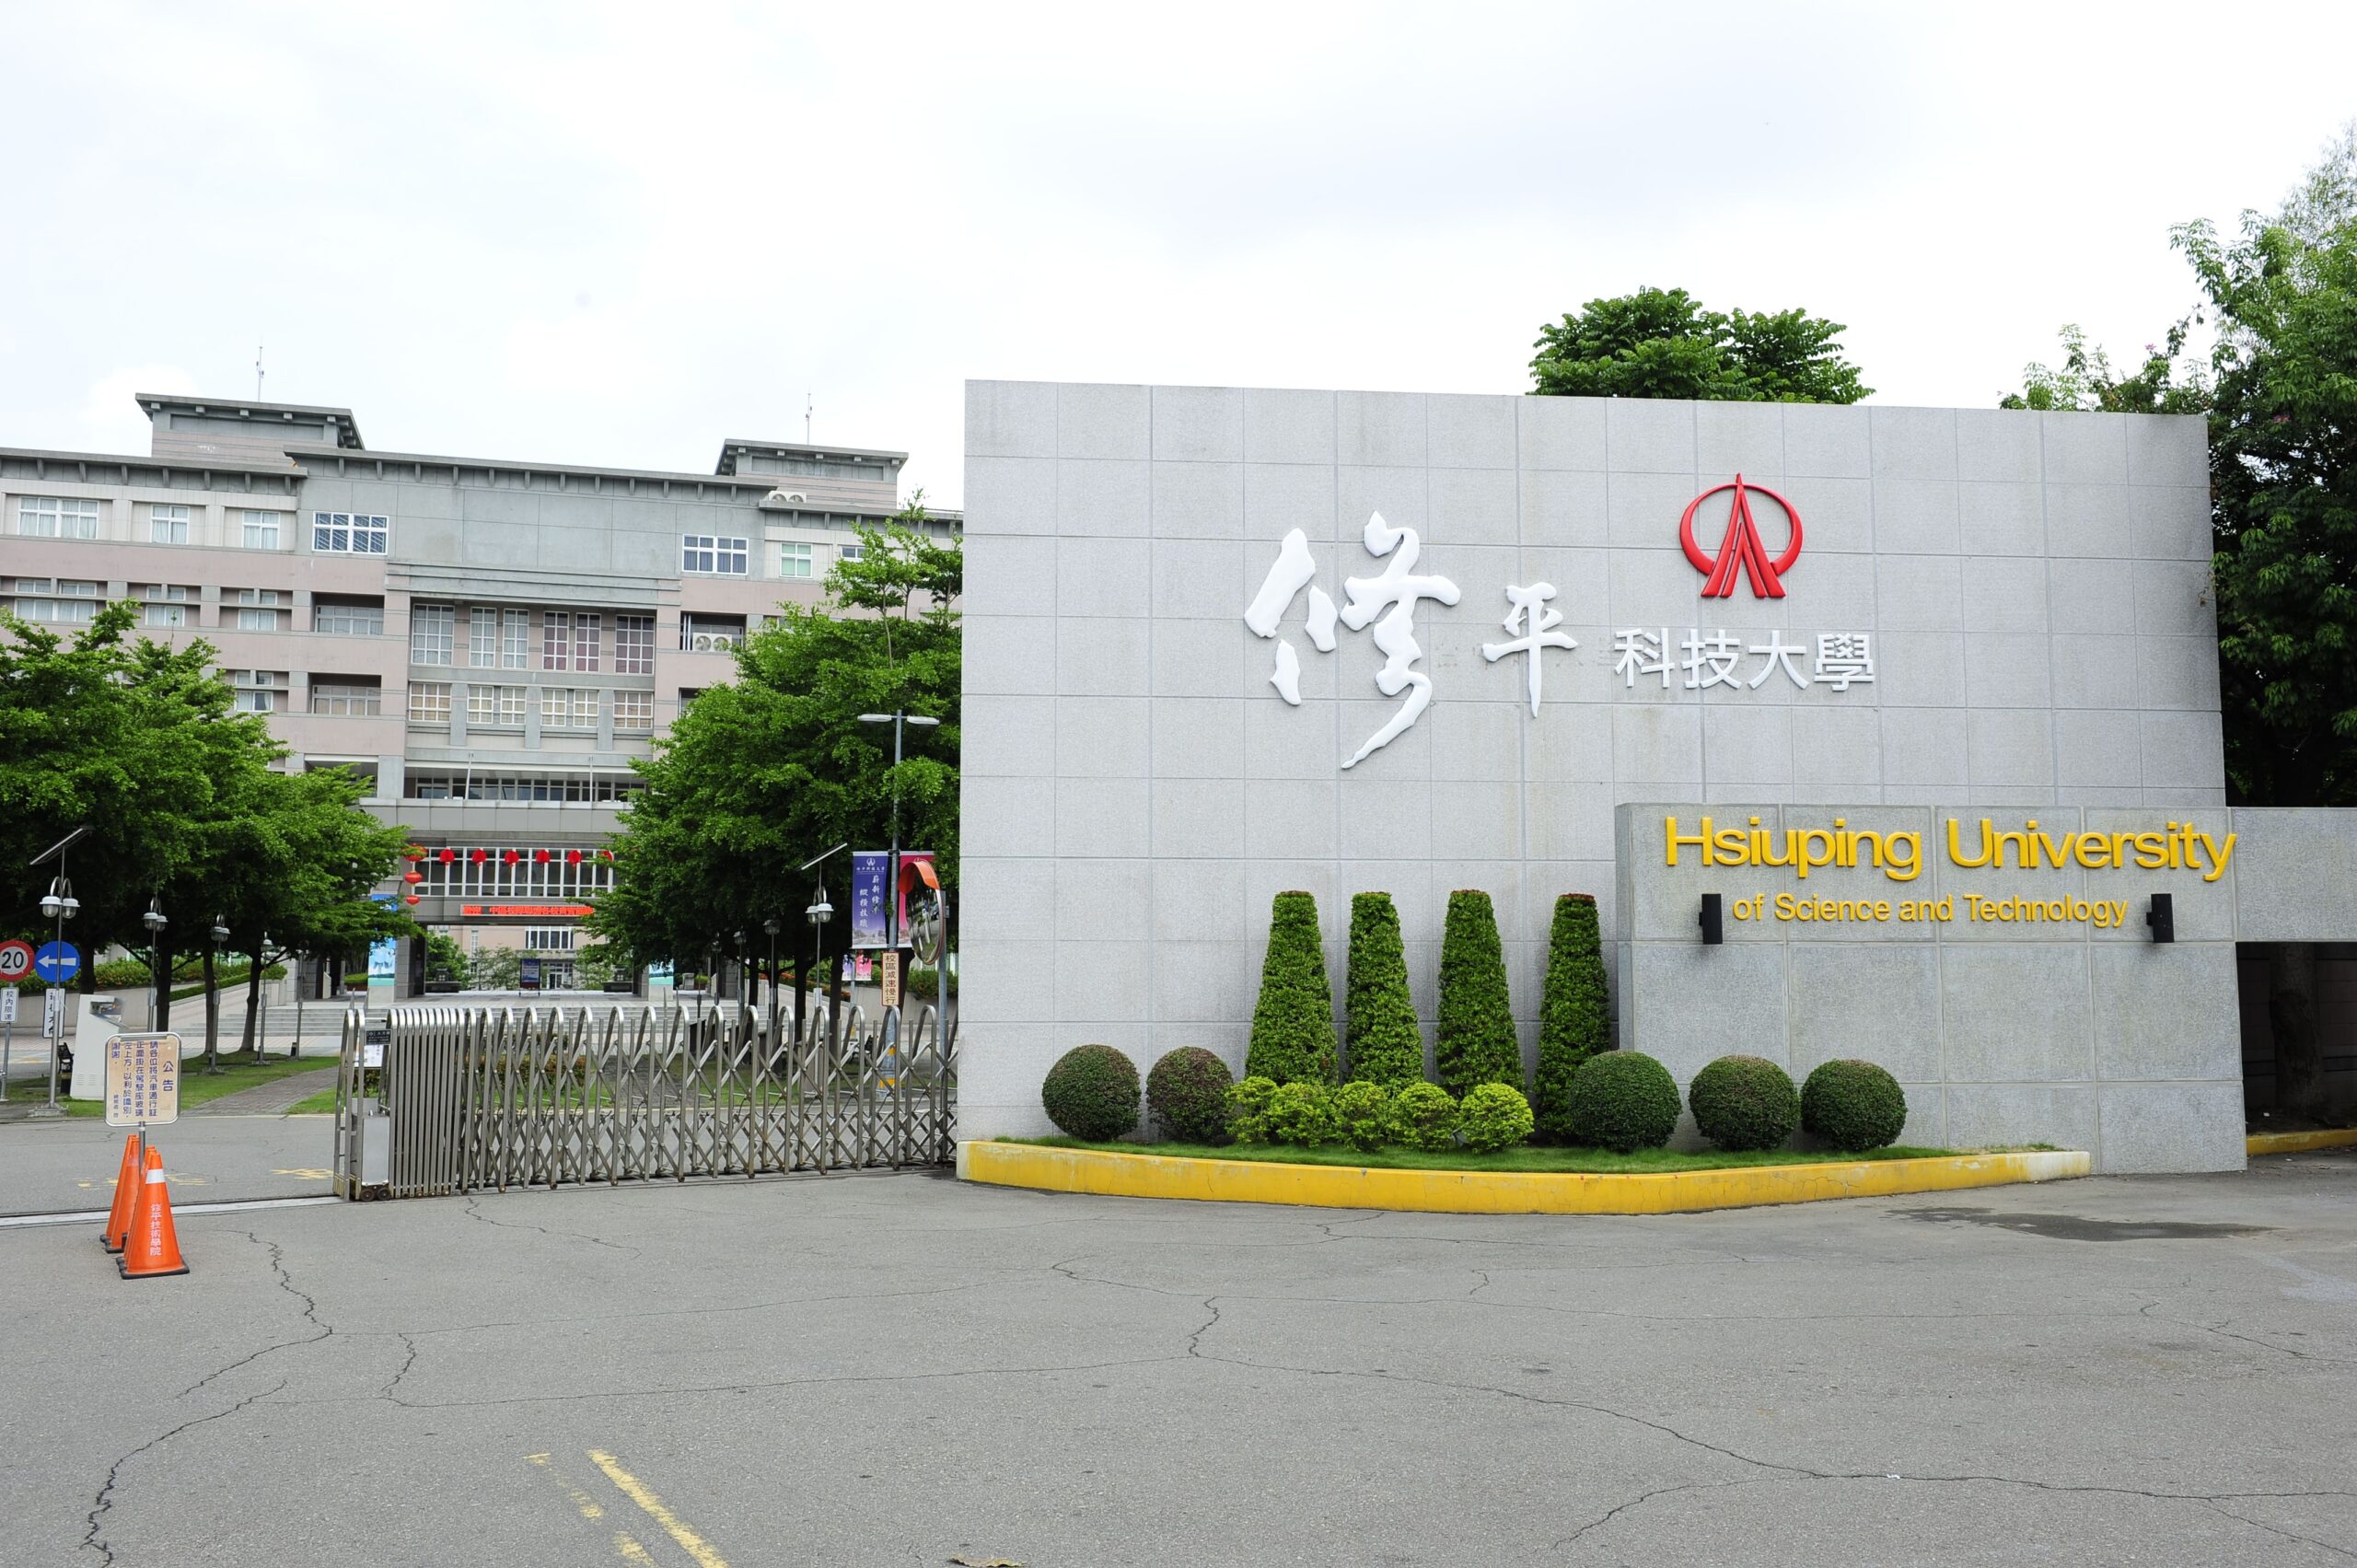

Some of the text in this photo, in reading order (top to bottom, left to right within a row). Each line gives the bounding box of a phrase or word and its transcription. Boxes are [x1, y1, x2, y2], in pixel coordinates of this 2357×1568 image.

[1244, 510, 1875, 769] 修平 科技大學
[1666, 817, 2237, 881] Hsiuping University
[1733, 893, 2129, 928] of Science and Technology
[1, 951, 24, 969] 20
[885, 954, 897, 1005] 校區減速慢行
[5, 991, 14, 1020] 校內限速
[163, 1061, 174, 1092] 公告
